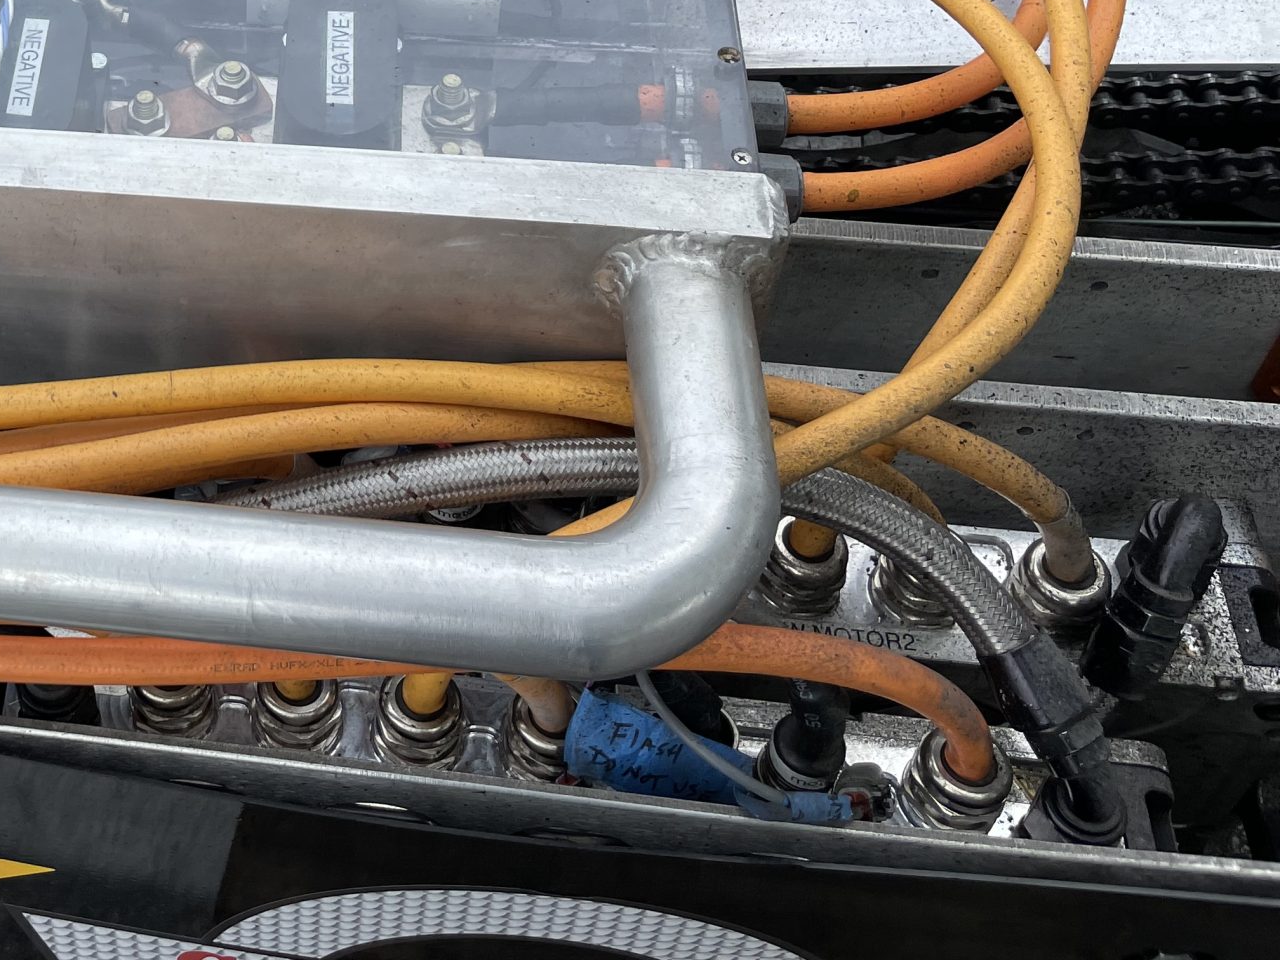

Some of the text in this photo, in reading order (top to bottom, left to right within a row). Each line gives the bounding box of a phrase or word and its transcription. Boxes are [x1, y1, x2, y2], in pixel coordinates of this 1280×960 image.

[10, 28, 44, 107] NEGATIVE
[331, 18, 351, 98] NEGATIVE
[621, 766, 669, 791] NOT
